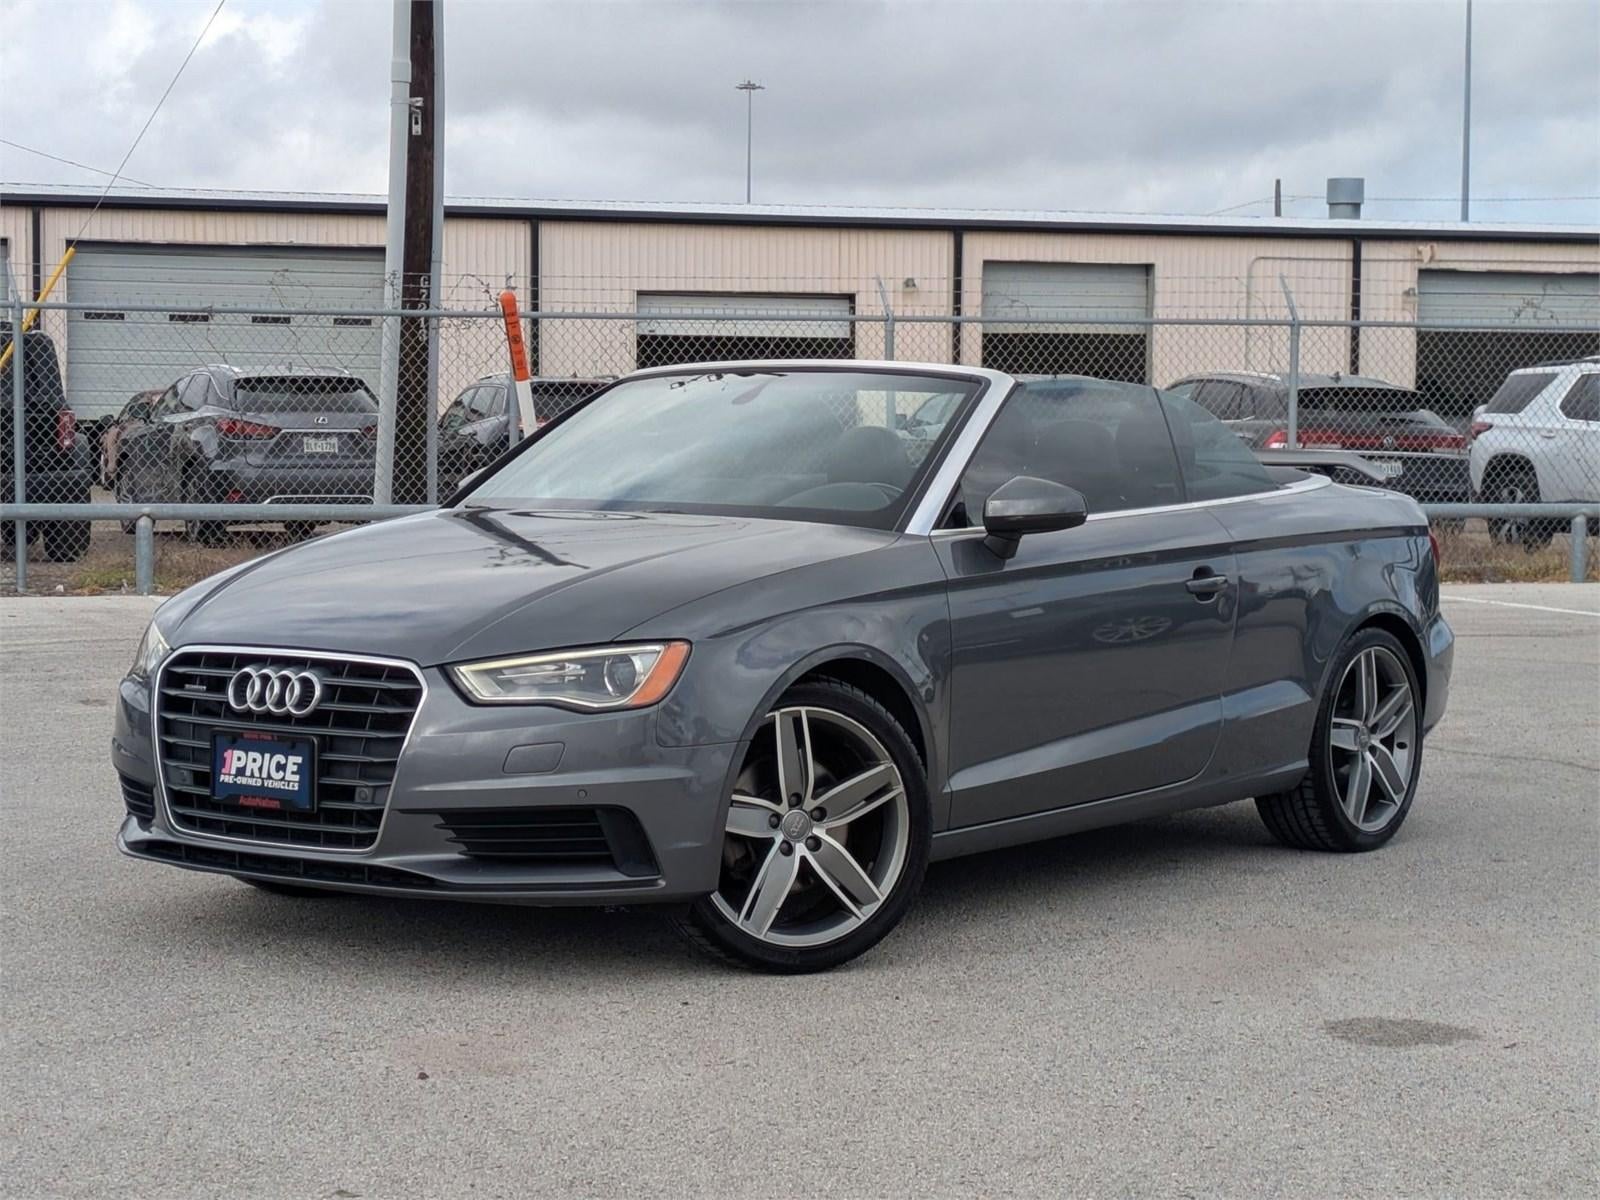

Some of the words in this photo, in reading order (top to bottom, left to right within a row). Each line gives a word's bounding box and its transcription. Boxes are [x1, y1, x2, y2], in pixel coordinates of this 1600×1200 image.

[221, 749, 303, 781] 1PRICE
[219, 774, 262, 787] PRE-OWNED
[264, 779, 300, 791] VEHICLES
